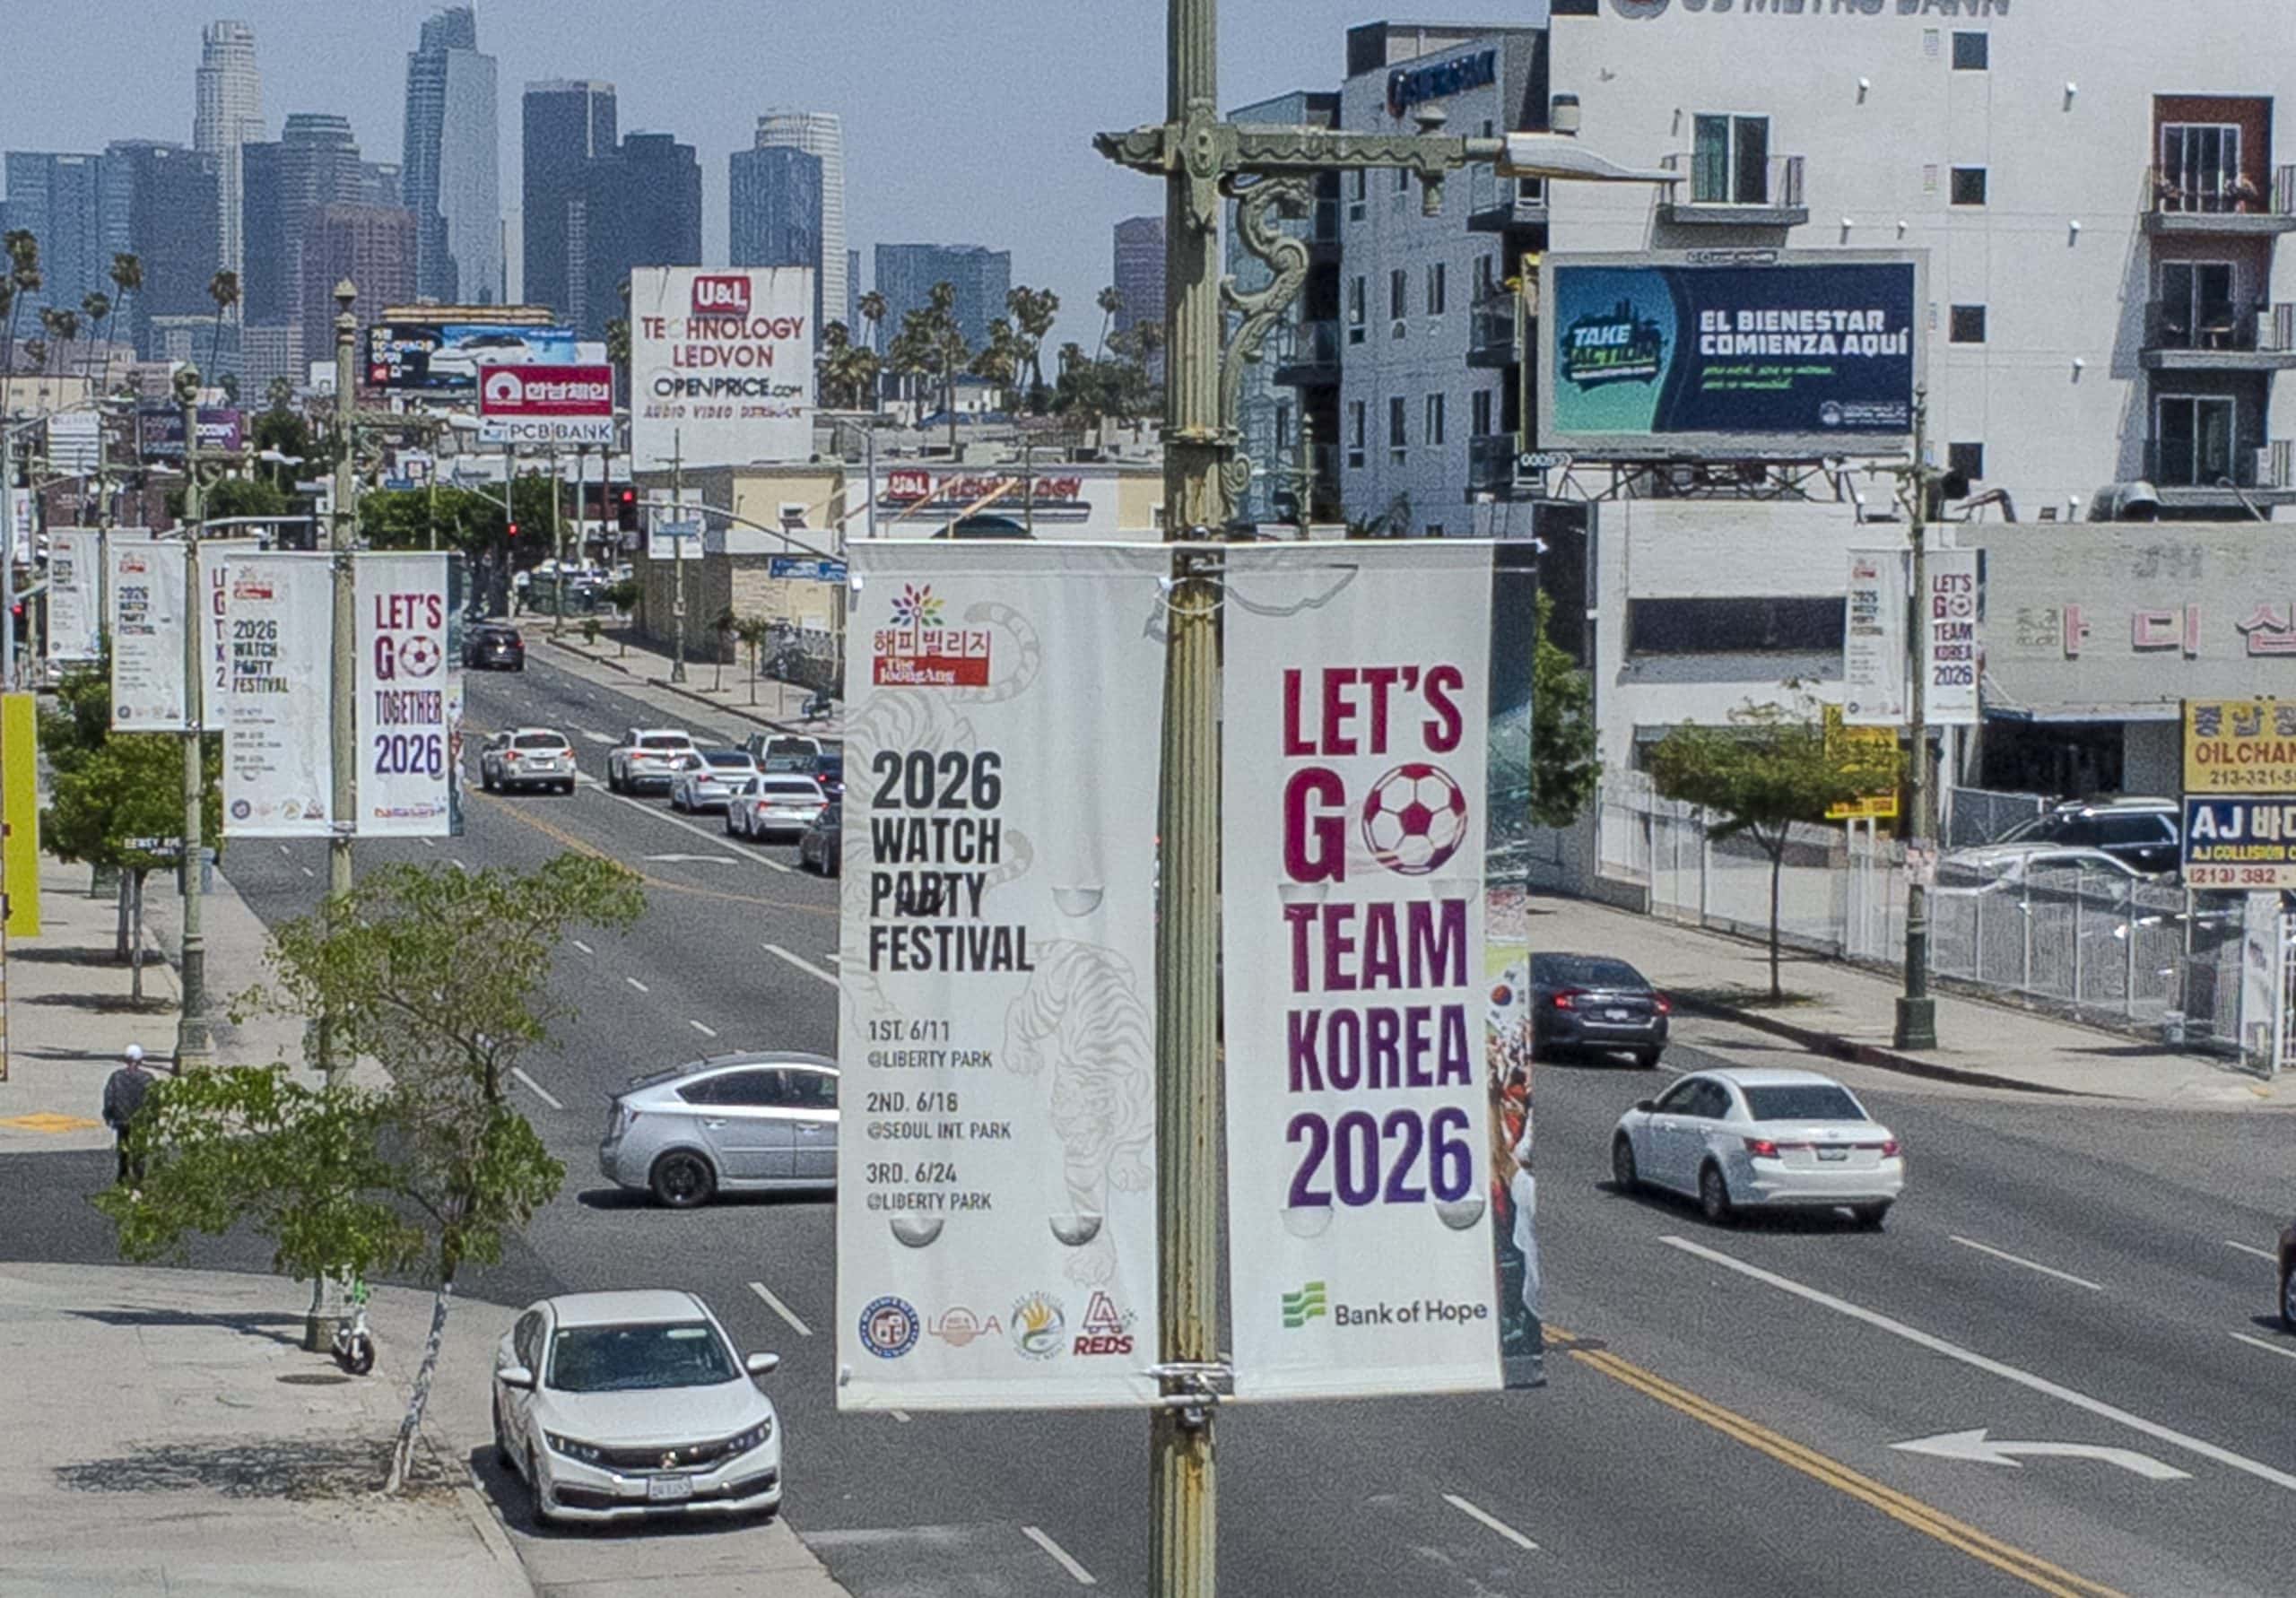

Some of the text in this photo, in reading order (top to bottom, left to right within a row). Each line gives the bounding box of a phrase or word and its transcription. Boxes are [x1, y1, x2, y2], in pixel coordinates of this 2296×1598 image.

[697, 281, 747, 307] U&L
[641, 317, 805, 340] TEHNOLOGY
[1700, 310, 1884, 332] EL BIENESTAR
[1573, 324, 1631, 347] TAKE
[1700, 327, 1909, 358] COMIENZA AQUÍ
[674, 345, 774, 368] LEDVON
[509, 423, 611, 439] PCB BANK
[375, 594, 441, 630] LET'S
[233, 620, 278, 639] 2026
[874, 630, 991, 657] 해피빌리지
[1934, 665, 1973, 686] 2026
[375, 690, 443, 725] TOGETHER
[1283, 664, 1465, 758] LET'S
[375, 734, 442, 776] 2026
[872, 750, 1002, 810] 2026
[2191, 805, 2242, 839] AJ
[871, 816, 1001, 864] WATCH
[870, 871, 987, 919] PARTY
[869, 925, 1036, 973] FESTIVAL
[1283, 898, 1468, 993] TEAM
[909, 1020, 950, 1041] 6/11
[867, 1050, 993, 1068] @LIBERTY PARK
[1287, 1003, 1472, 1093] KOREA
[866, 1091, 959, 1113] 2ND. 6/18
[867, 1122, 933, 1140] @SEOUL
[970, 1122, 1012, 1140] PARK
[1286, 1106, 1473, 1210] 2026
[866, 1162, 958, 1184] 3RD. 6/24
[866, 1193, 992, 1211] @LIBERTY PARK
[1335, 1300, 1488, 1326] Bank of Hope
[1073, 1334, 1135, 1356] REDS
